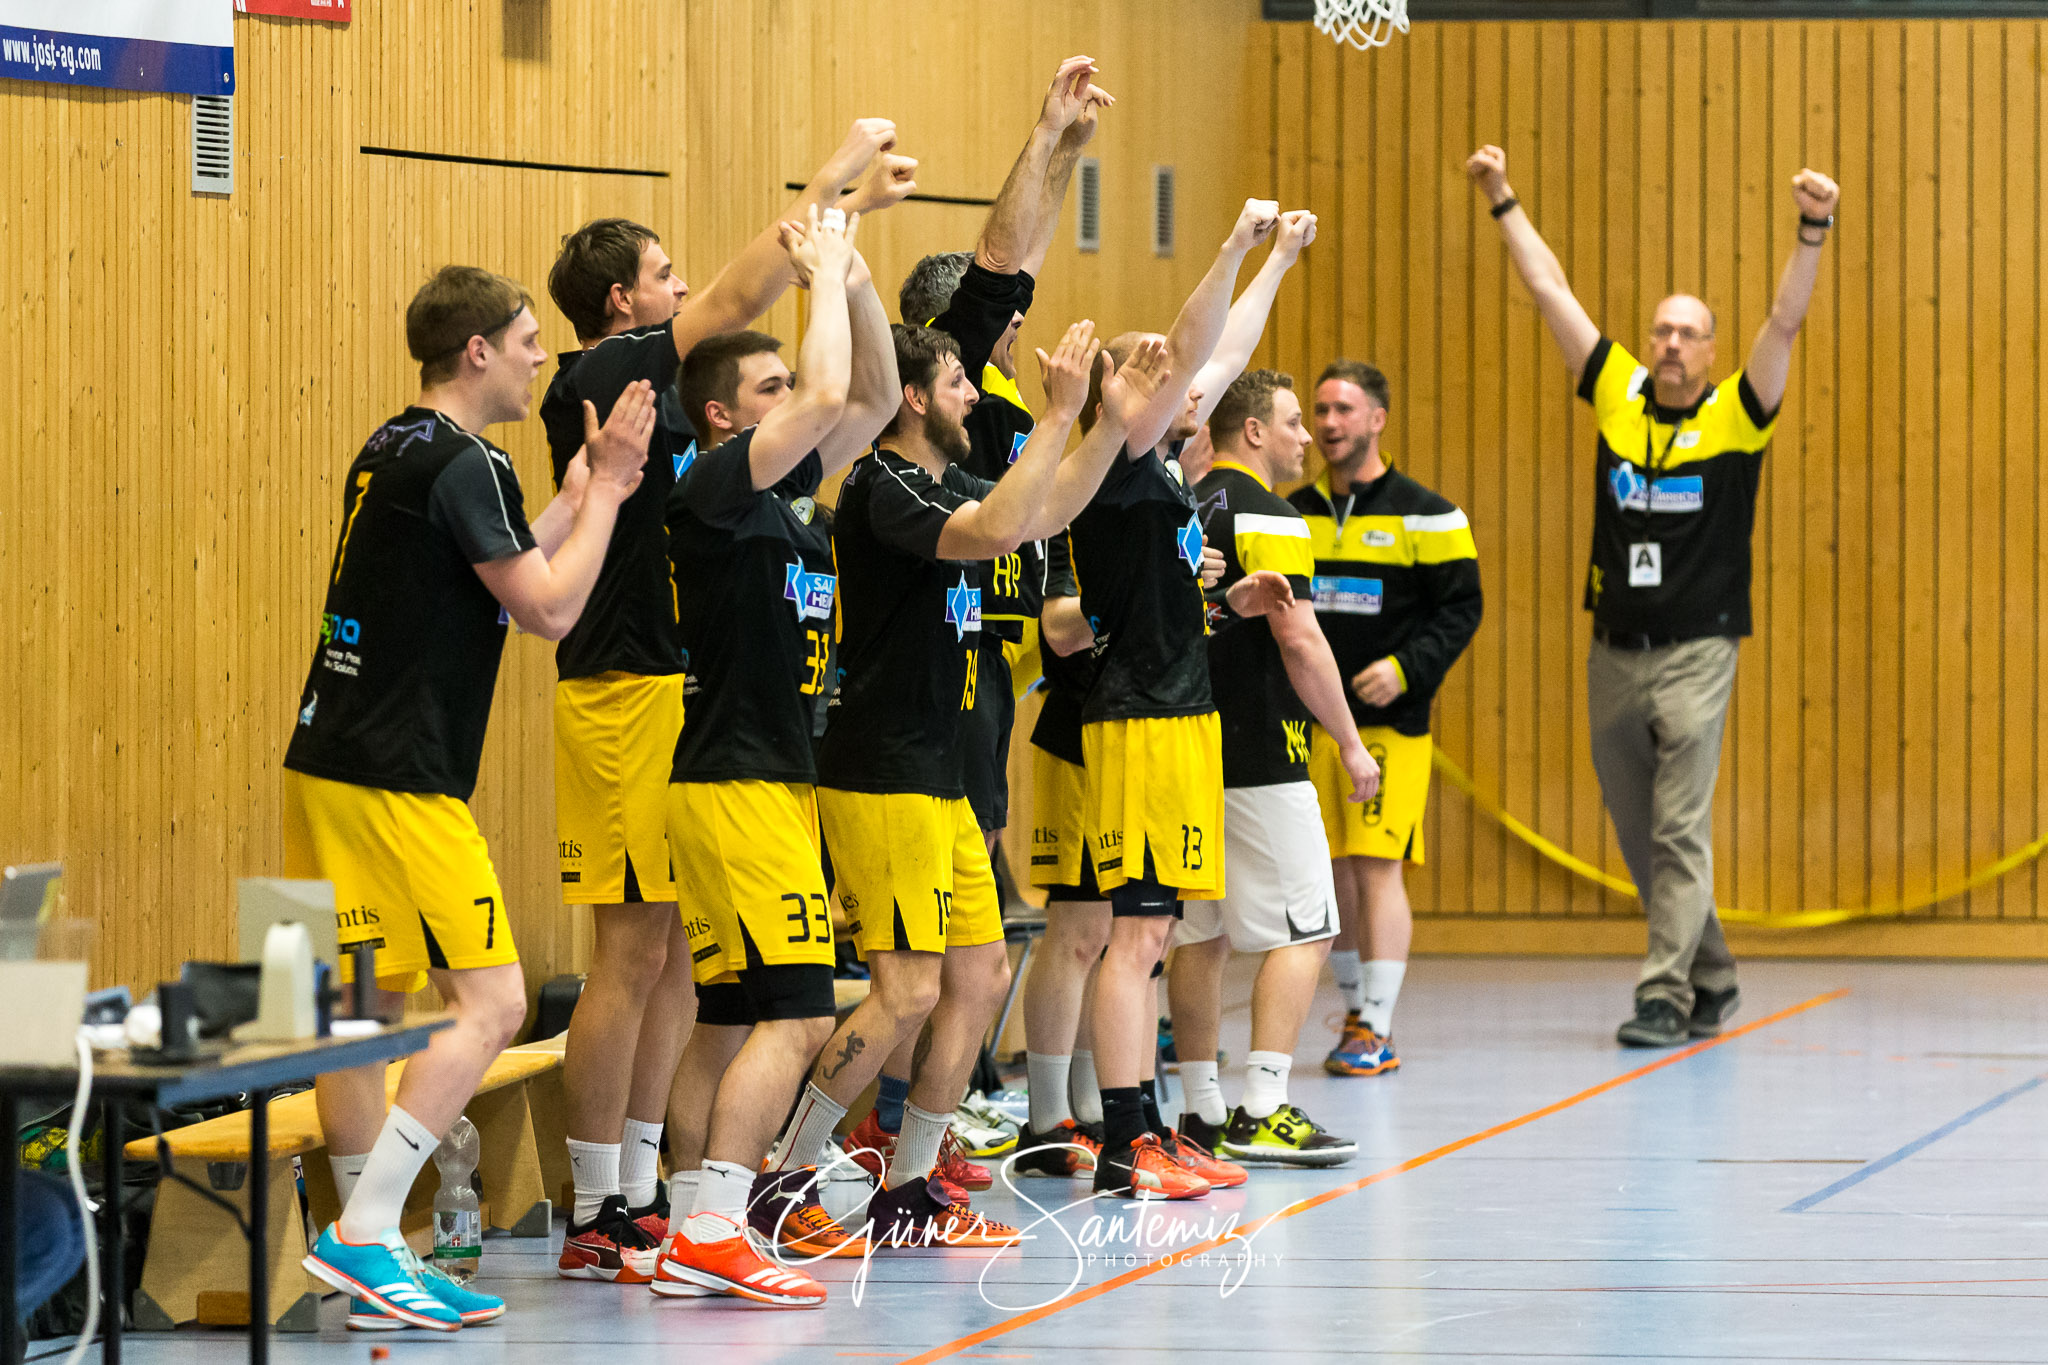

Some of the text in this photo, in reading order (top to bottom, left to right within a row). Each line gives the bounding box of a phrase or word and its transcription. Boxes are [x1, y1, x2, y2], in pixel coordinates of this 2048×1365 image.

[3, 34, 102, 76] www.jost-ag.com
[992, 552, 1022, 598] HP
[1181, 823, 1203, 871] 13
[474, 896, 495, 949] 7
[781, 893, 831, 943] 33
